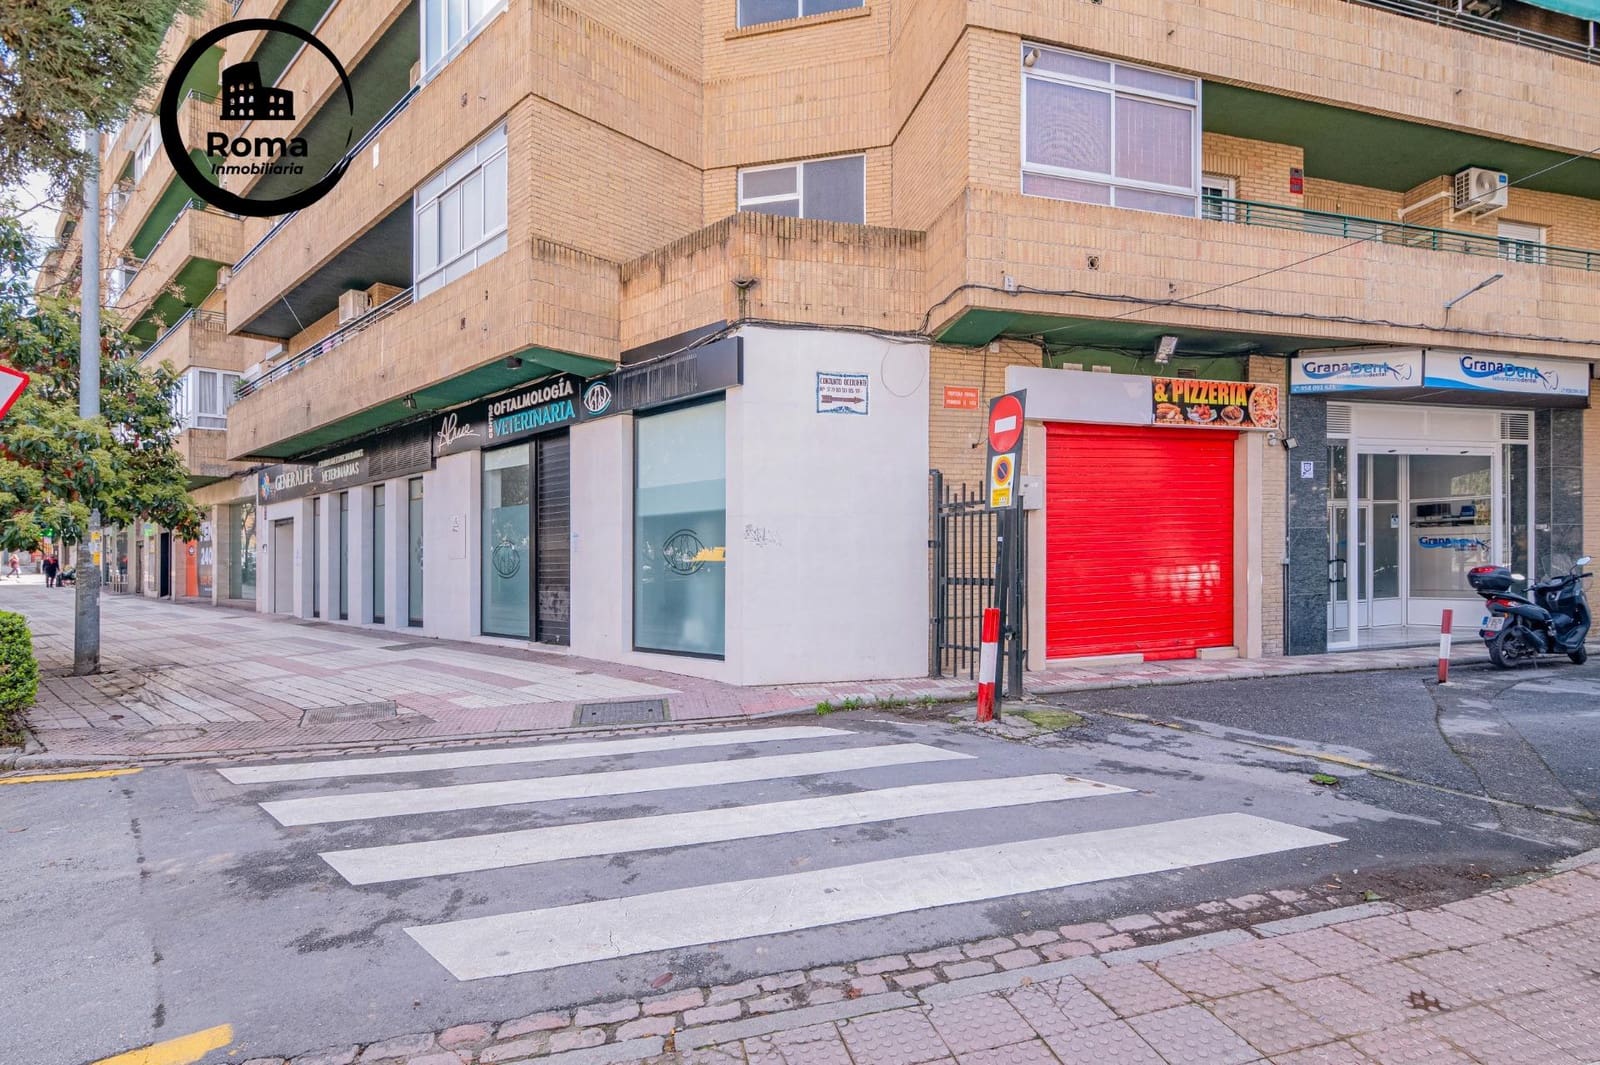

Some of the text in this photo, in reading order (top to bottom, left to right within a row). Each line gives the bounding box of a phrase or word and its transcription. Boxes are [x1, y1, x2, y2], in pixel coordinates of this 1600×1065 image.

[1304, 361, 1388, 375] GranaDent
[1461, 356, 1539, 378] GranaDent
[494, 377, 574, 415] OFTALMOLOGÍA
[1154, 380, 1248, 406] & PIZZERIA
[494, 400, 576, 437] VETERINARIA
[275, 465, 314, 490] GENERALIFE
